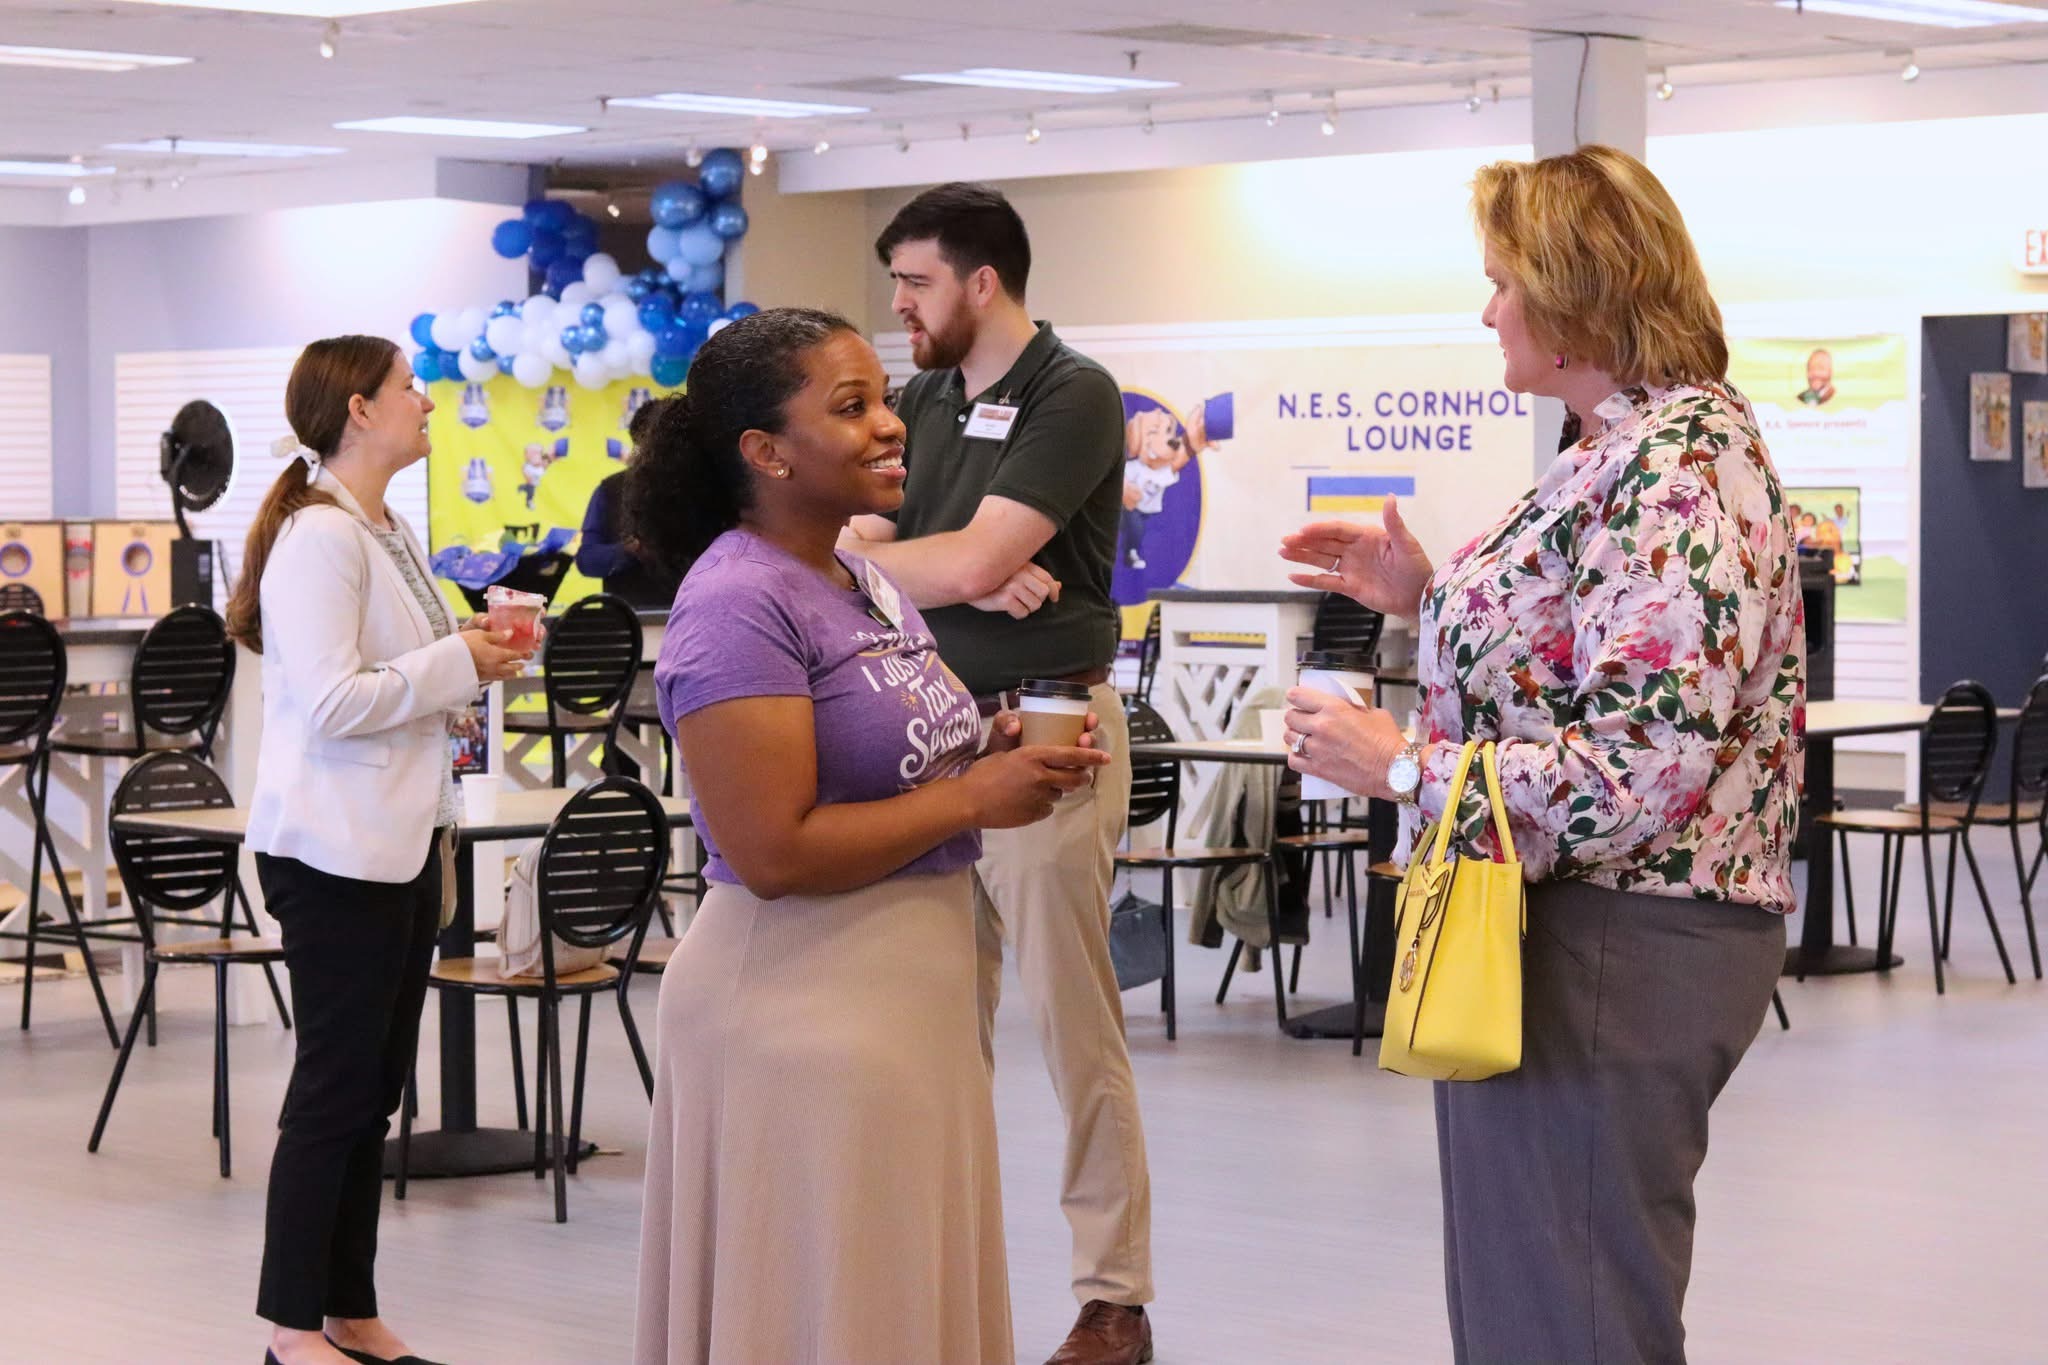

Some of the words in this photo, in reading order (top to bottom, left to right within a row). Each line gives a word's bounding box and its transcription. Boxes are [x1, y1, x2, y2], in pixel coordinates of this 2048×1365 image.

[1278, 393, 1362, 418] N.E.S.
[1347, 424, 1473, 451] LOUNGE
[861, 666, 882, 692] I
[907, 675, 958, 723] Tax
[900, 701, 982, 779] Season
